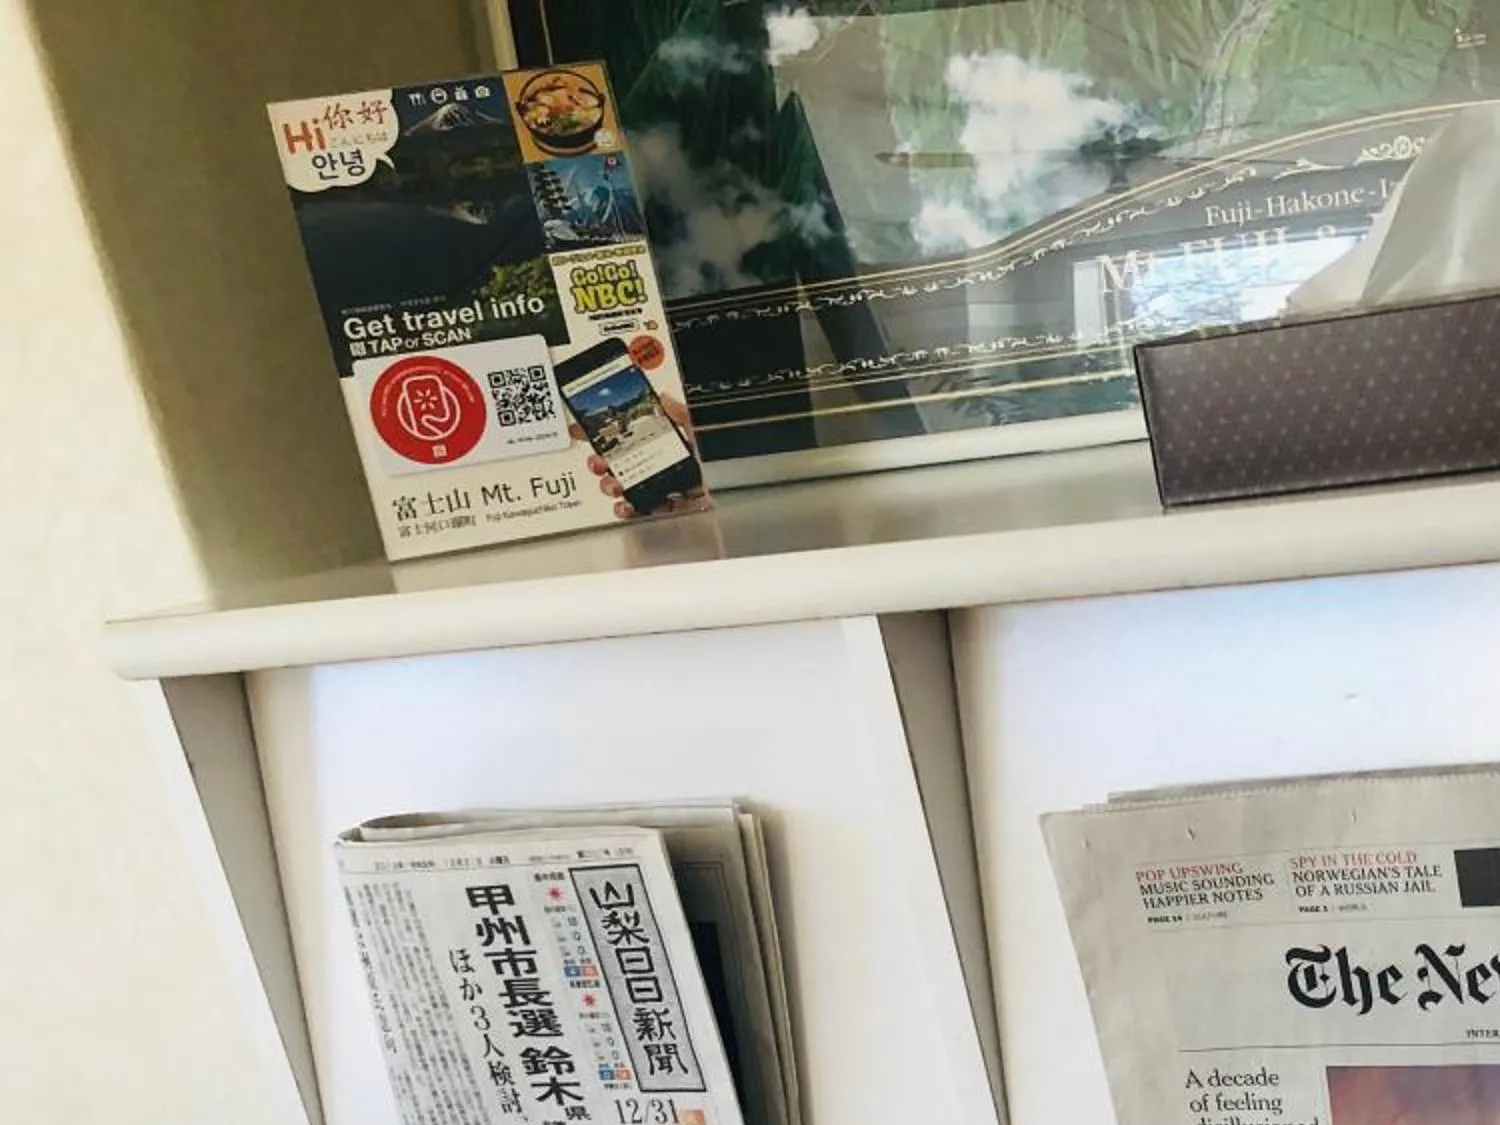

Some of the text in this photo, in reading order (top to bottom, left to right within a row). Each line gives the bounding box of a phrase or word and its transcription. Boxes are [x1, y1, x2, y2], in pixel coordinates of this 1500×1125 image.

[323, 100, 388, 130] 你好
[283, 118, 326, 155] Hi
[312, 148, 365, 180] 안녕
[571, 278, 648, 314] NBC!
[343, 313, 397, 340] Get
[402, 299, 484, 332] travel
[491, 294, 544, 319] info
[367, 327, 472, 355] TAP or SCAN
[480, 471, 577, 508] Mt. Fuji
[392, 488, 471, 521] 富士山
[1136, 862, 1244, 883] POP UPSWING
[1290, 850, 1418, 870] SPY IN THE COLD
[1292, 863, 1443, 884] NORWEGIAN'S TALE
[1140, 871, 1276, 897] MUSIC SOUNDING
[1295, 884, 1318, 898] OF
[1320, 883, 1332, 896] A
[1333, 880, 1400, 896] RUSSIAN
[1143, 887, 1265, 911] HAPPIER NOTES
[465, 883, 565, 1039] 甲州市長選
[588, 880, 689, 1076] 山梨日日新聞
[1285, 943, 1408, 1016] The
[1185, 1066, 1280, 1089] A decade
[615, 1098, 681, 1125] 12/31
[1189, 1091, 1284, 1116] of feeling
